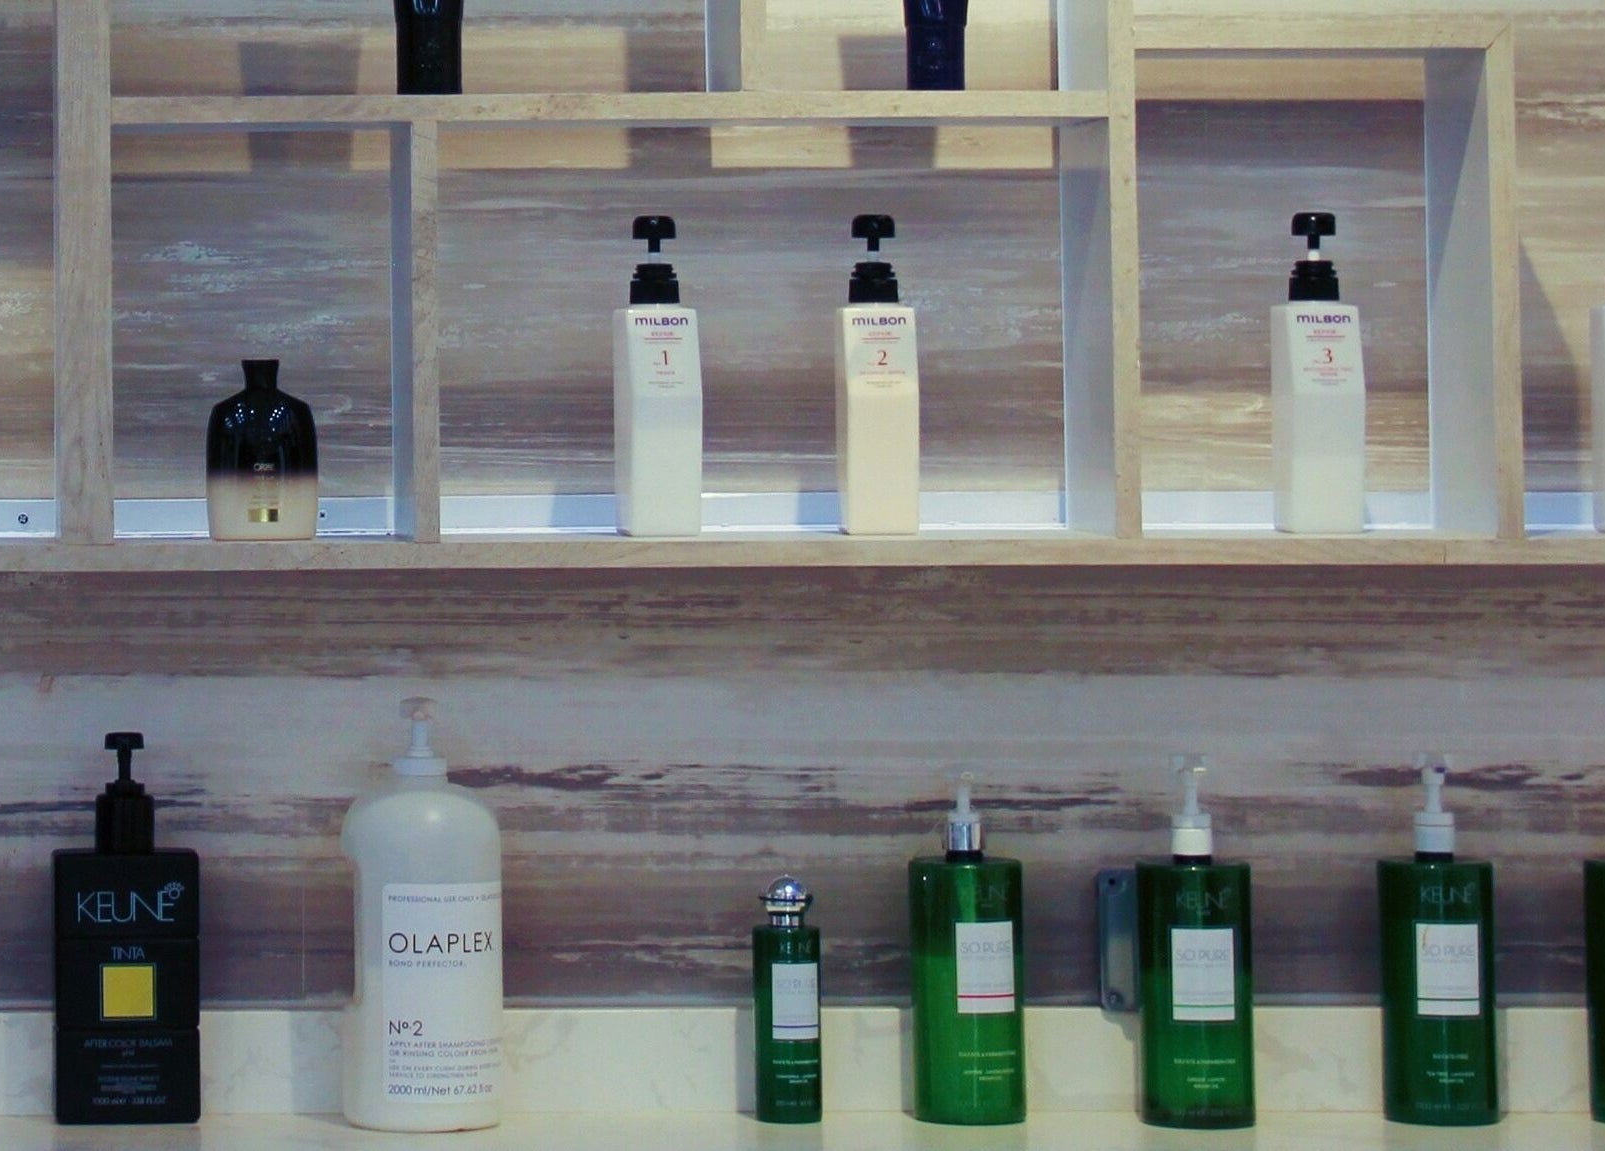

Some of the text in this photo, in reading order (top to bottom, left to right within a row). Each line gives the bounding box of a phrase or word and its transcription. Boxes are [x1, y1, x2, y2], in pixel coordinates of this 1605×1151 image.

[662, 350, 669, 366] 1
[877, 350, 888, 365] 2
[1322, 348, 1333, 364] 3
[77, 888, 177, 923] KEUNE
[388, 932, 493, 954] OLAPLEX
[111, 947, 145, 960] TINTA
[388, 960, 412, 968] BOND
[83, 1038, 107, 1048] AFTER
[439, 1040, 485, 1048] SHAMPOOING
[402, 1050, 435, 1058] RINSING
[437, 1049, 469, 1058] COLOUR
[416, 1071, 425, 1079] TO
[388, 1084, 412, 1095] 2000
[454, 1084, 477, 1095] 67.62
